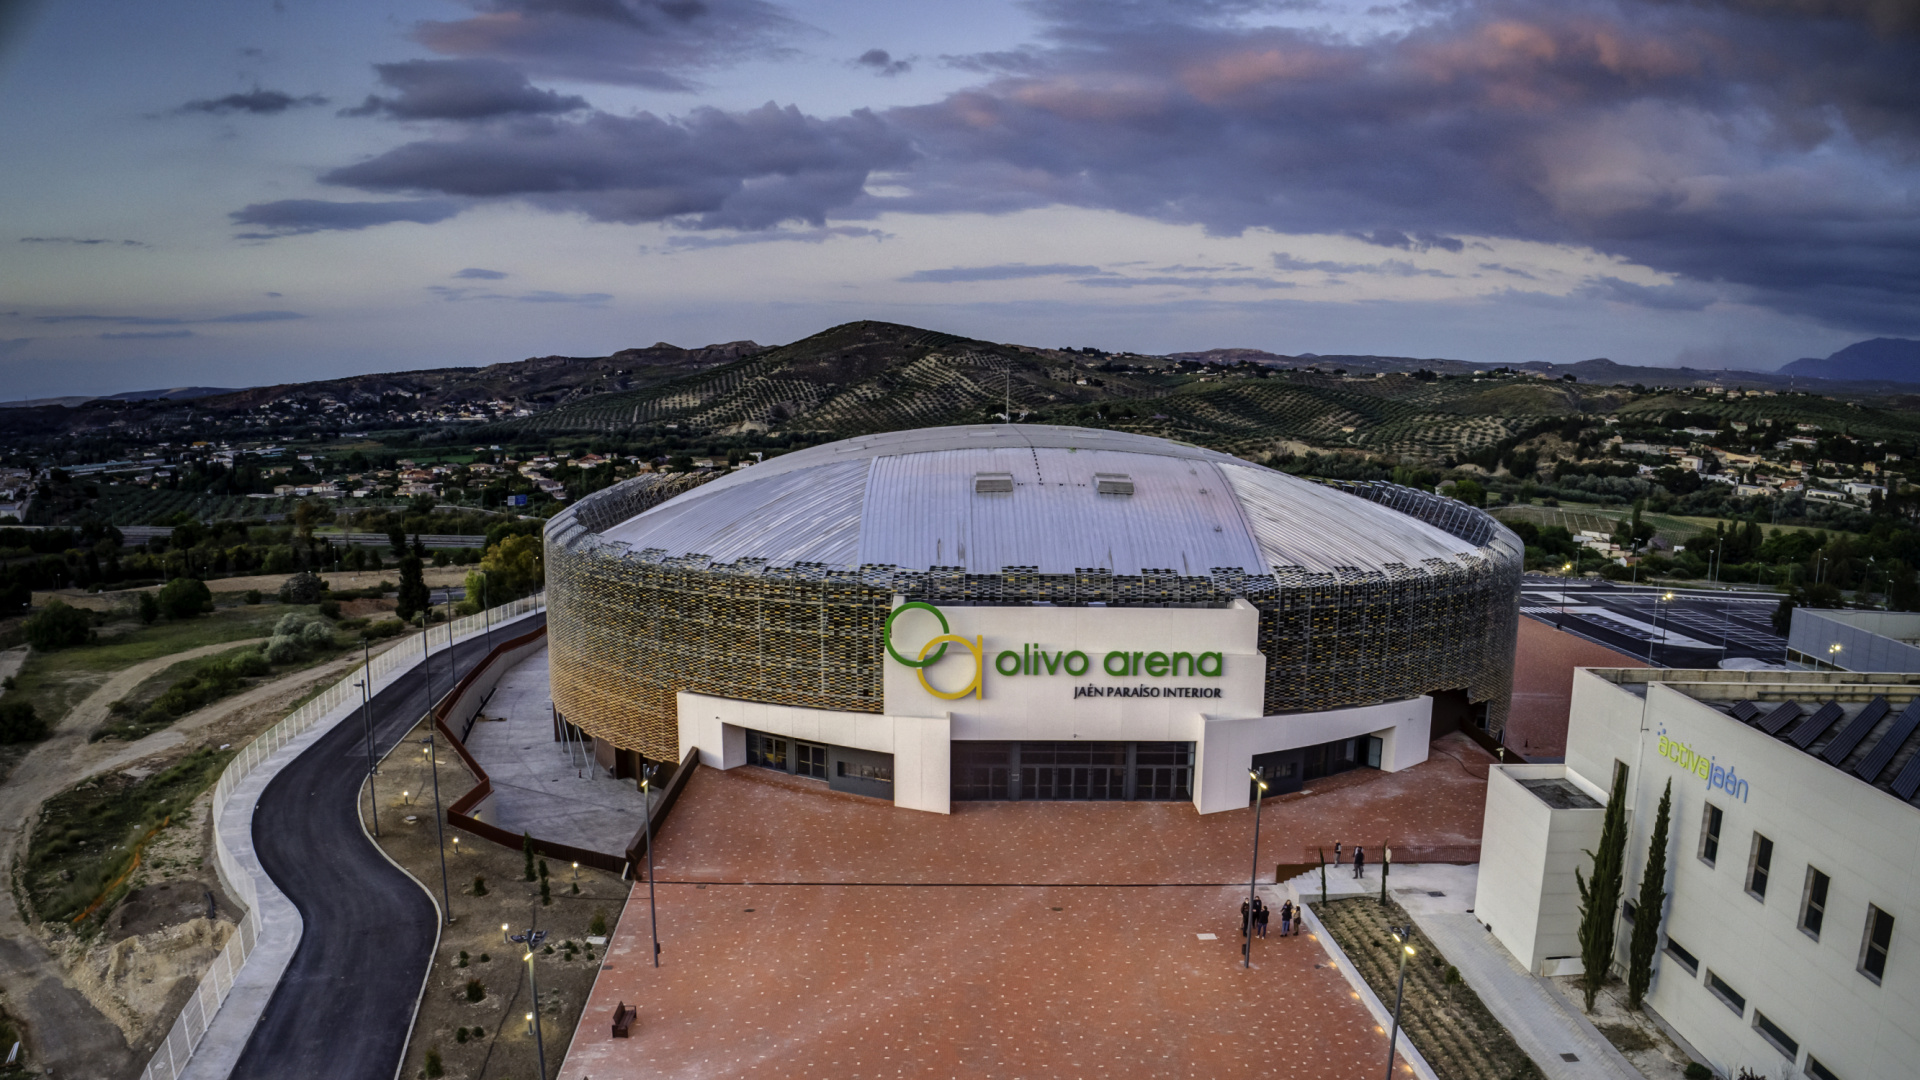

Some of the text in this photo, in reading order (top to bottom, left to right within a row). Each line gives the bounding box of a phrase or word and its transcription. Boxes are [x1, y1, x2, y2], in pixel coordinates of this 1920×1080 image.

[995, 643, 1223, 677] olivo arena
[1074, 683, 1222, 699] JAÉN PARAÍSO INTERIOR
